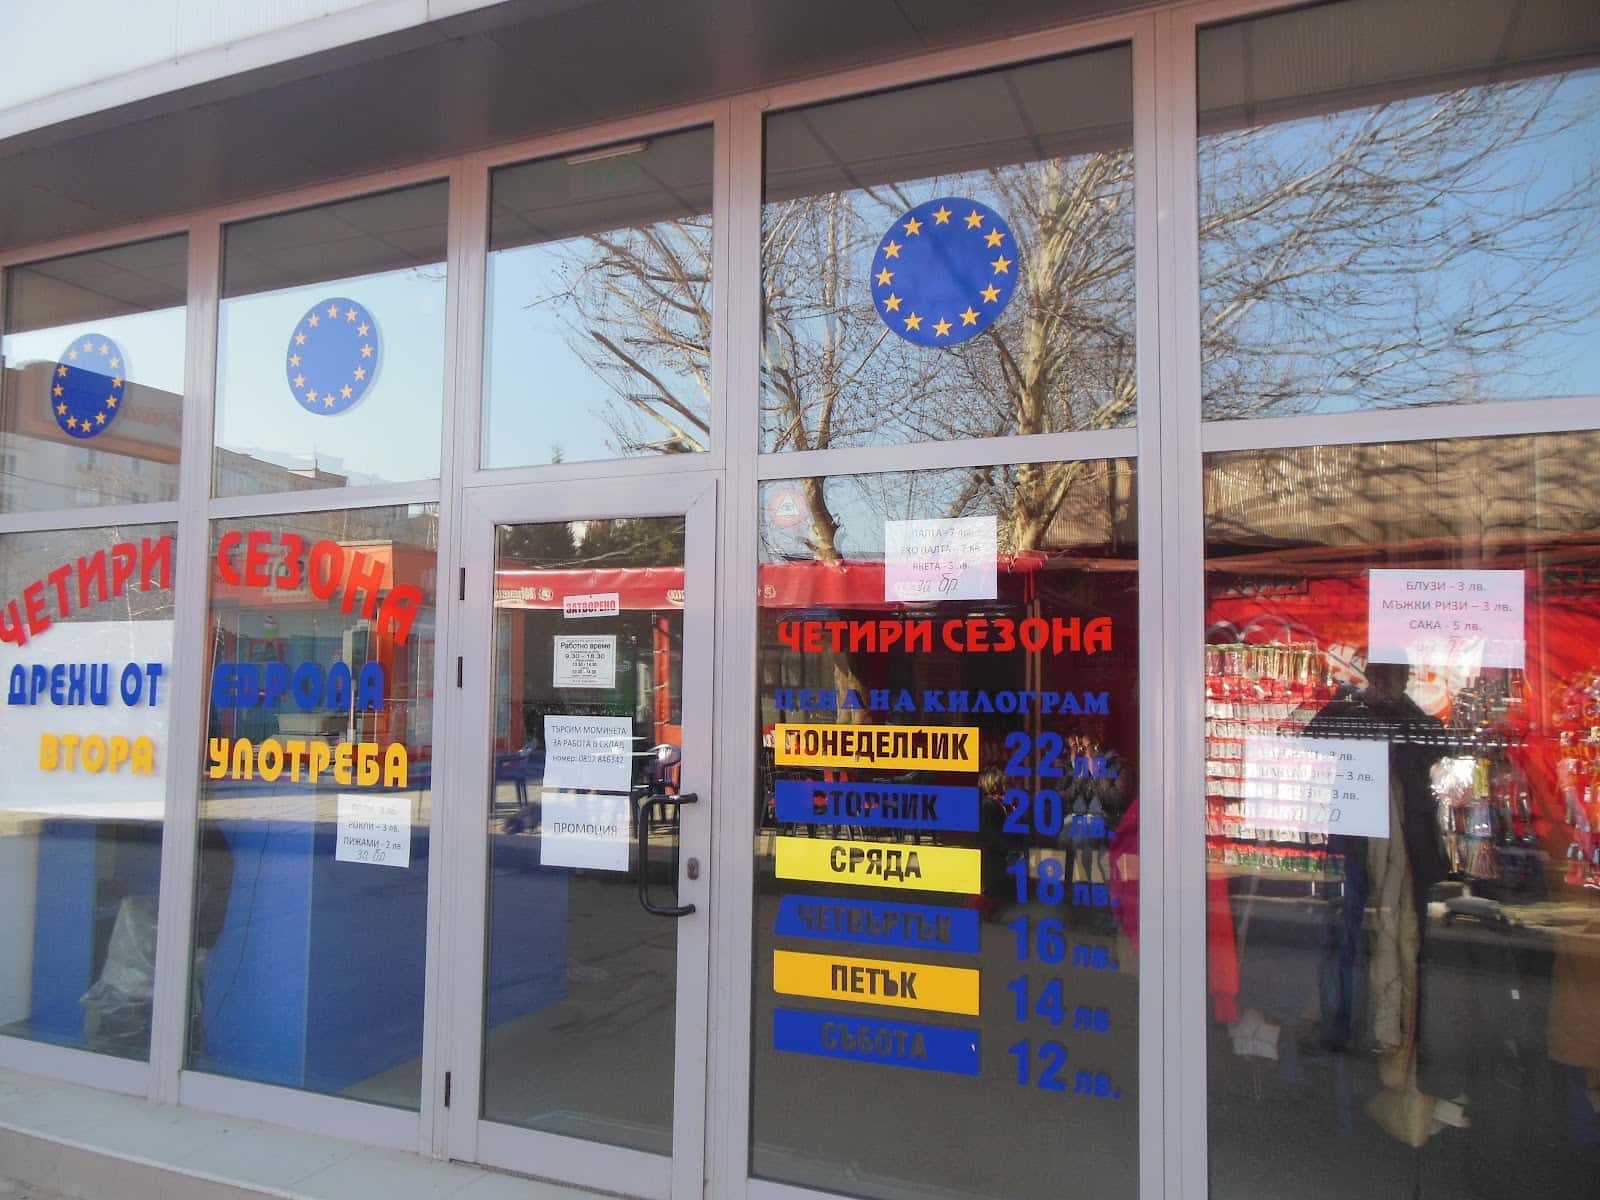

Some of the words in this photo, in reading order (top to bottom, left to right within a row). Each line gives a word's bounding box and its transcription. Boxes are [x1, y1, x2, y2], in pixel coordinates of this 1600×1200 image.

[0, 535, 176, 647] ЧЕТИРИ
[217, 531, 422, 647] СЕЗОНА
[1406, 581, 1446, 591] БЛУЗИ
[1457, 582, 1465, 591] 3
[1468, 583, 1488, 591] лв.
[565, 602, 617, 615] ЗАТВОРЕНО
[1382, 600, 1430, 610] МЪЖКИ
[1435, 601, 1468, 611] РИЗИ
[1483, 602, 1490, 611] 3
[1494, 603, 1513, 612] лв.
[779, 619, 932, 653] ЧЕТИРИ
[942, 616, 1113, 656] СЕЗОНА
[1409, 620, 1442, 630] САКА
[1453, 621, 1461, 630] 5
[1464, 622, 1482, 631] лв.
[560, 641, 588, 650] Работно
[590, 642, 611, 650] време
[7, 663, 109, 706] ДРЕХИ
[120, 662, 165, 706] ОТ
[212, 661, 385, 711] ЕВРОПА
[774, 688, 863, 712] ЦЕНА
[870, 689, 917, 713] НА
[922, 690, 1110, 715] КИЛОГРАМ
[551, 725, 581, 735] ТЪРСИМ
[583, 726, 627, 735] МОМИЧЕТА
[563, 739, 591, 748] РАБОТА
[39, 733, 156, 775] ВТОРА
[208, 738, 409, 787] УПОТРЕБА
[784, 728, 969, 763] ПОНЕДЕЛНИК
[1004, 731, 1064, 778] 22
[1347, 771, 1354, 781] 3
[812, 789, 939, 822] ВТОРНИК
[1002, 788, 1064, 836] 20
[553, 822, 618, 837] ПРОМОЦИЯ
[829, 845, 922, 883] СРЯДА
[1006, 856, 1065, 906] 18
[795, 902, 953, 945] ЧЕТВЪРТЪК
[1007, 914, 1066, 964] 16
[1072, 944, 1119, 970] лв.
[830, 964, 918, 1000] ПЕТЪК
[1007, 975, 1066, 1026] 14
[1073, 1006, 1110, 1033] лв
[822, 1021, 928, 1061] СЪБОТА
[1007, 1039, 1067, 1092] 12
[1074, 1070, 1121, 1099] лв.
